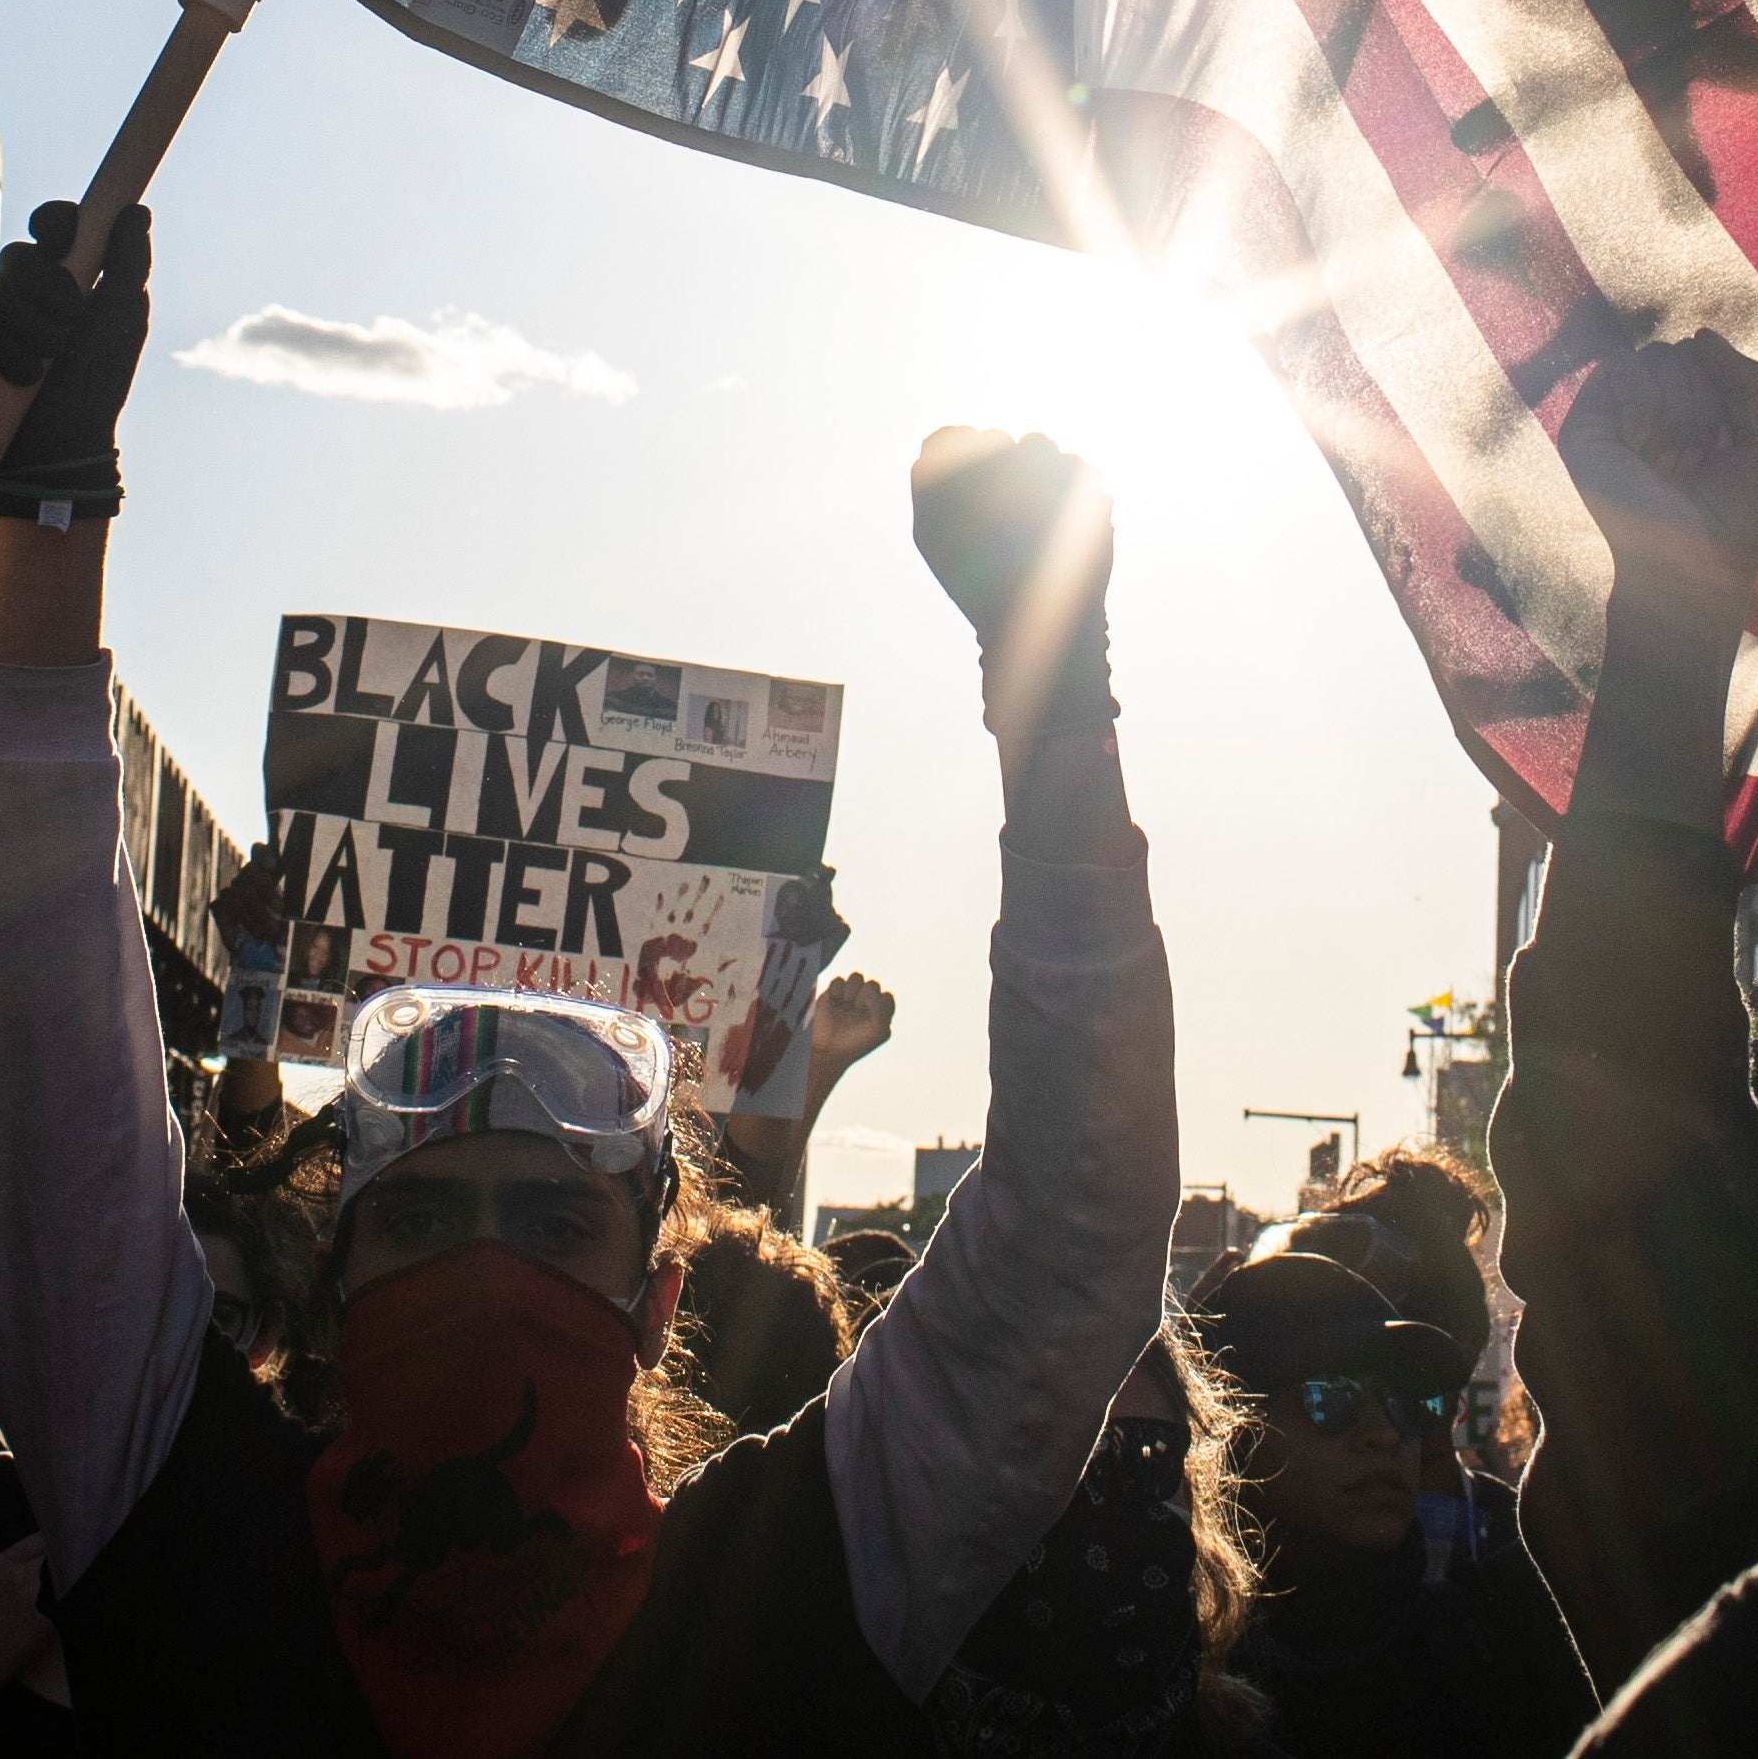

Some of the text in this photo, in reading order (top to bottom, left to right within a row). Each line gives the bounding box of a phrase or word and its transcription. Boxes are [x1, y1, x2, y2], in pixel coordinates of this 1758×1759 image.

[271, 615, 615, 747] BLACK
[363, 720, 692, 861] LIVES
[365, 933, 502, 984] STOP
